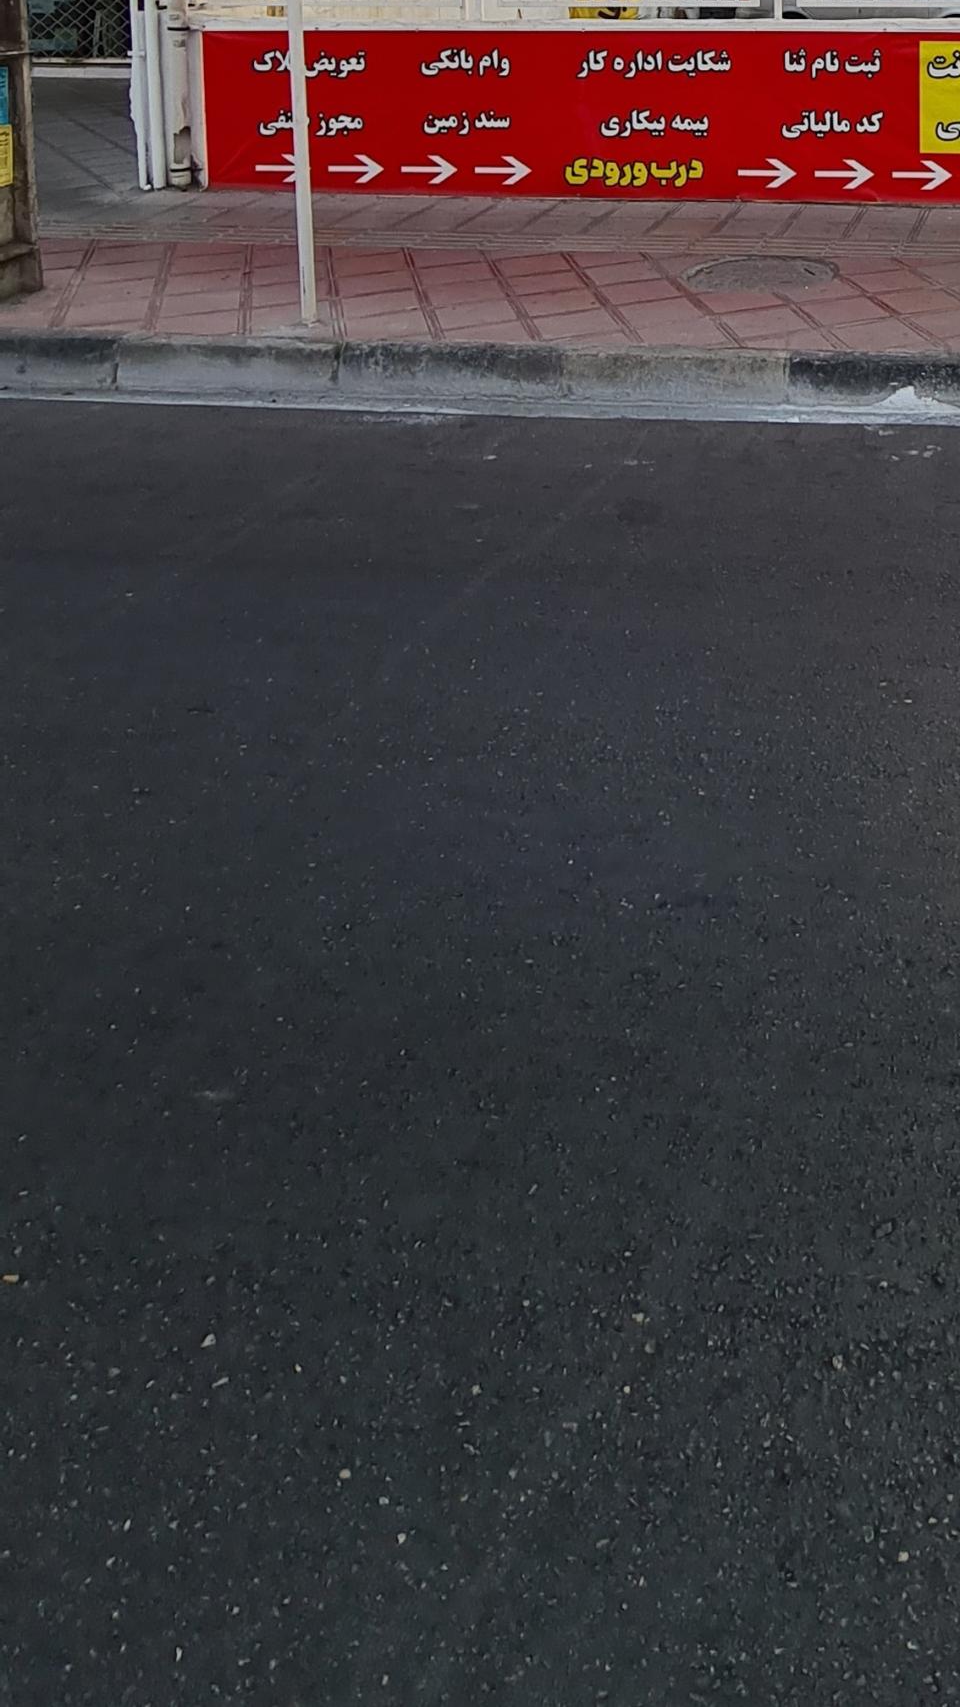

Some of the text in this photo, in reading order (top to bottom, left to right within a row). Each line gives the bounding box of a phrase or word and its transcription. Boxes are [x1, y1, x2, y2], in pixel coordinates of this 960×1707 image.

[253, 50, 367, 79] تعویض لاک
[420, 49, 511, 77] وام بانکی
[576, 50, 732, 78] شکایت اداره کار
[784, 48, 882, 79] ثبت نام ثنا
[259, 110, 364, 137] مجوز نفی
[423, 110, 511, 136] سند زمین
[599, 110, 710, 138] بیمه بیکاری
[781, 111, 884, 139] کد مالیاتی
[564, 156, 704, 188] درب ورودی
